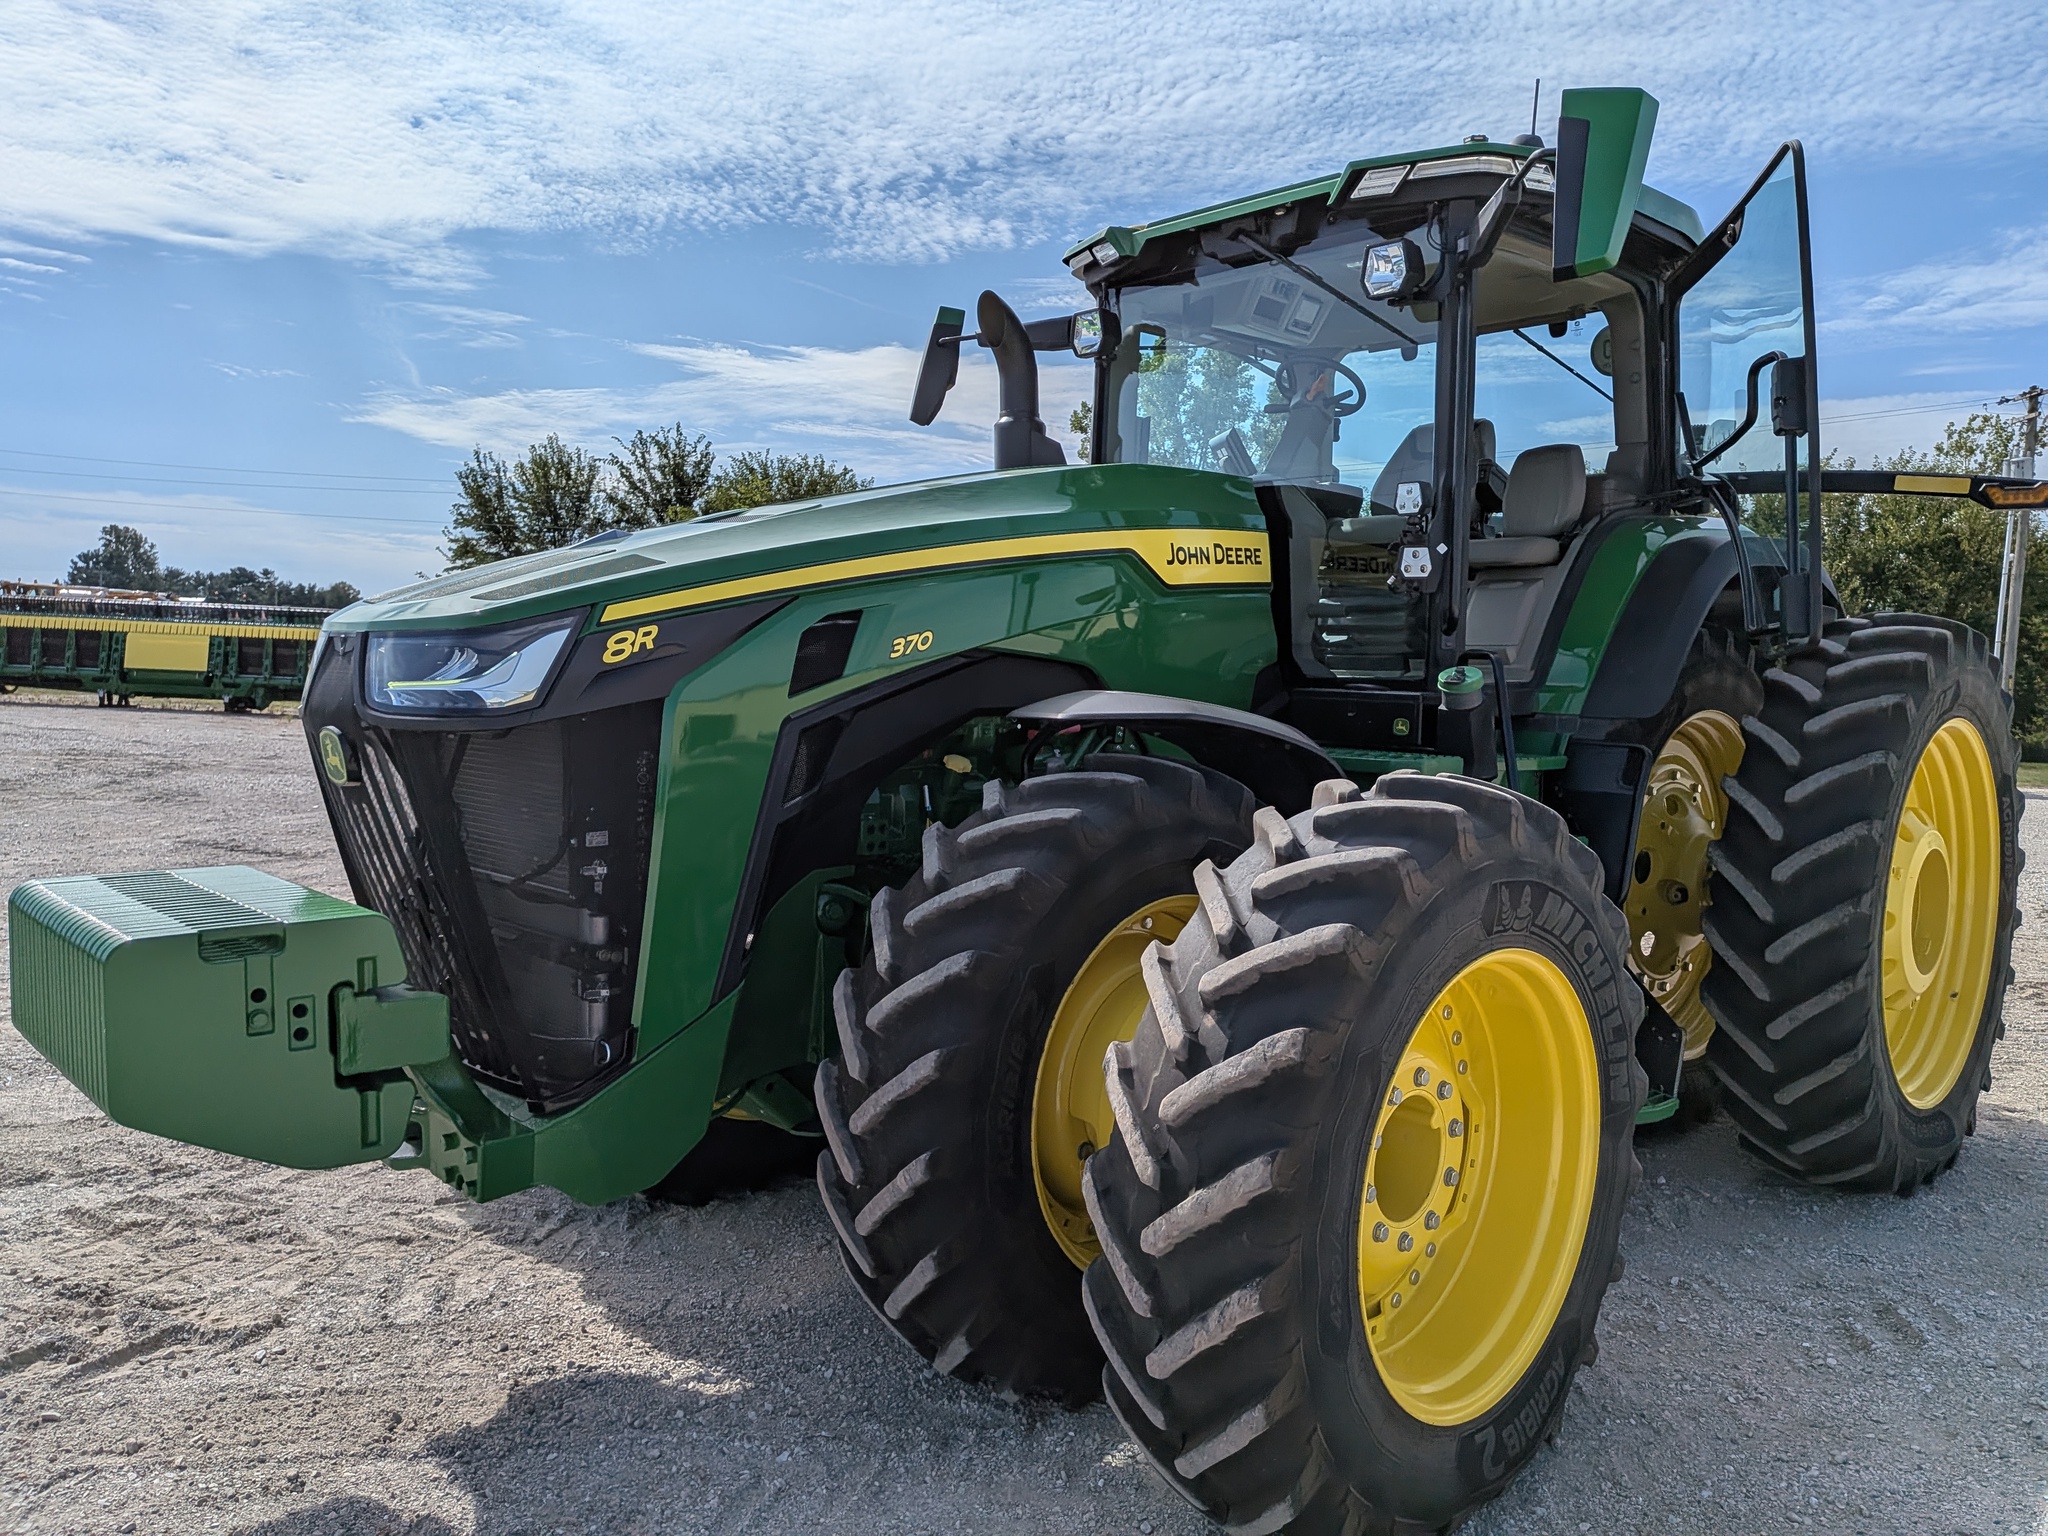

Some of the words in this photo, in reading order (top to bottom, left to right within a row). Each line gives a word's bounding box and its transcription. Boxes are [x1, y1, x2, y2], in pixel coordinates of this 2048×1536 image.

[1166, 542, 1210, 566] JOHN
[1213, 542, 1263, 566] DEERE
[601, 624, 659, 664] 8R
[889, 630, 935, 659] 370
[1535, 891, 1631, 1102] MICHELIN
[1501, 1348, 1566, 1458] AGRIBIB
[1474, 1425, 1506, 1481] 2
